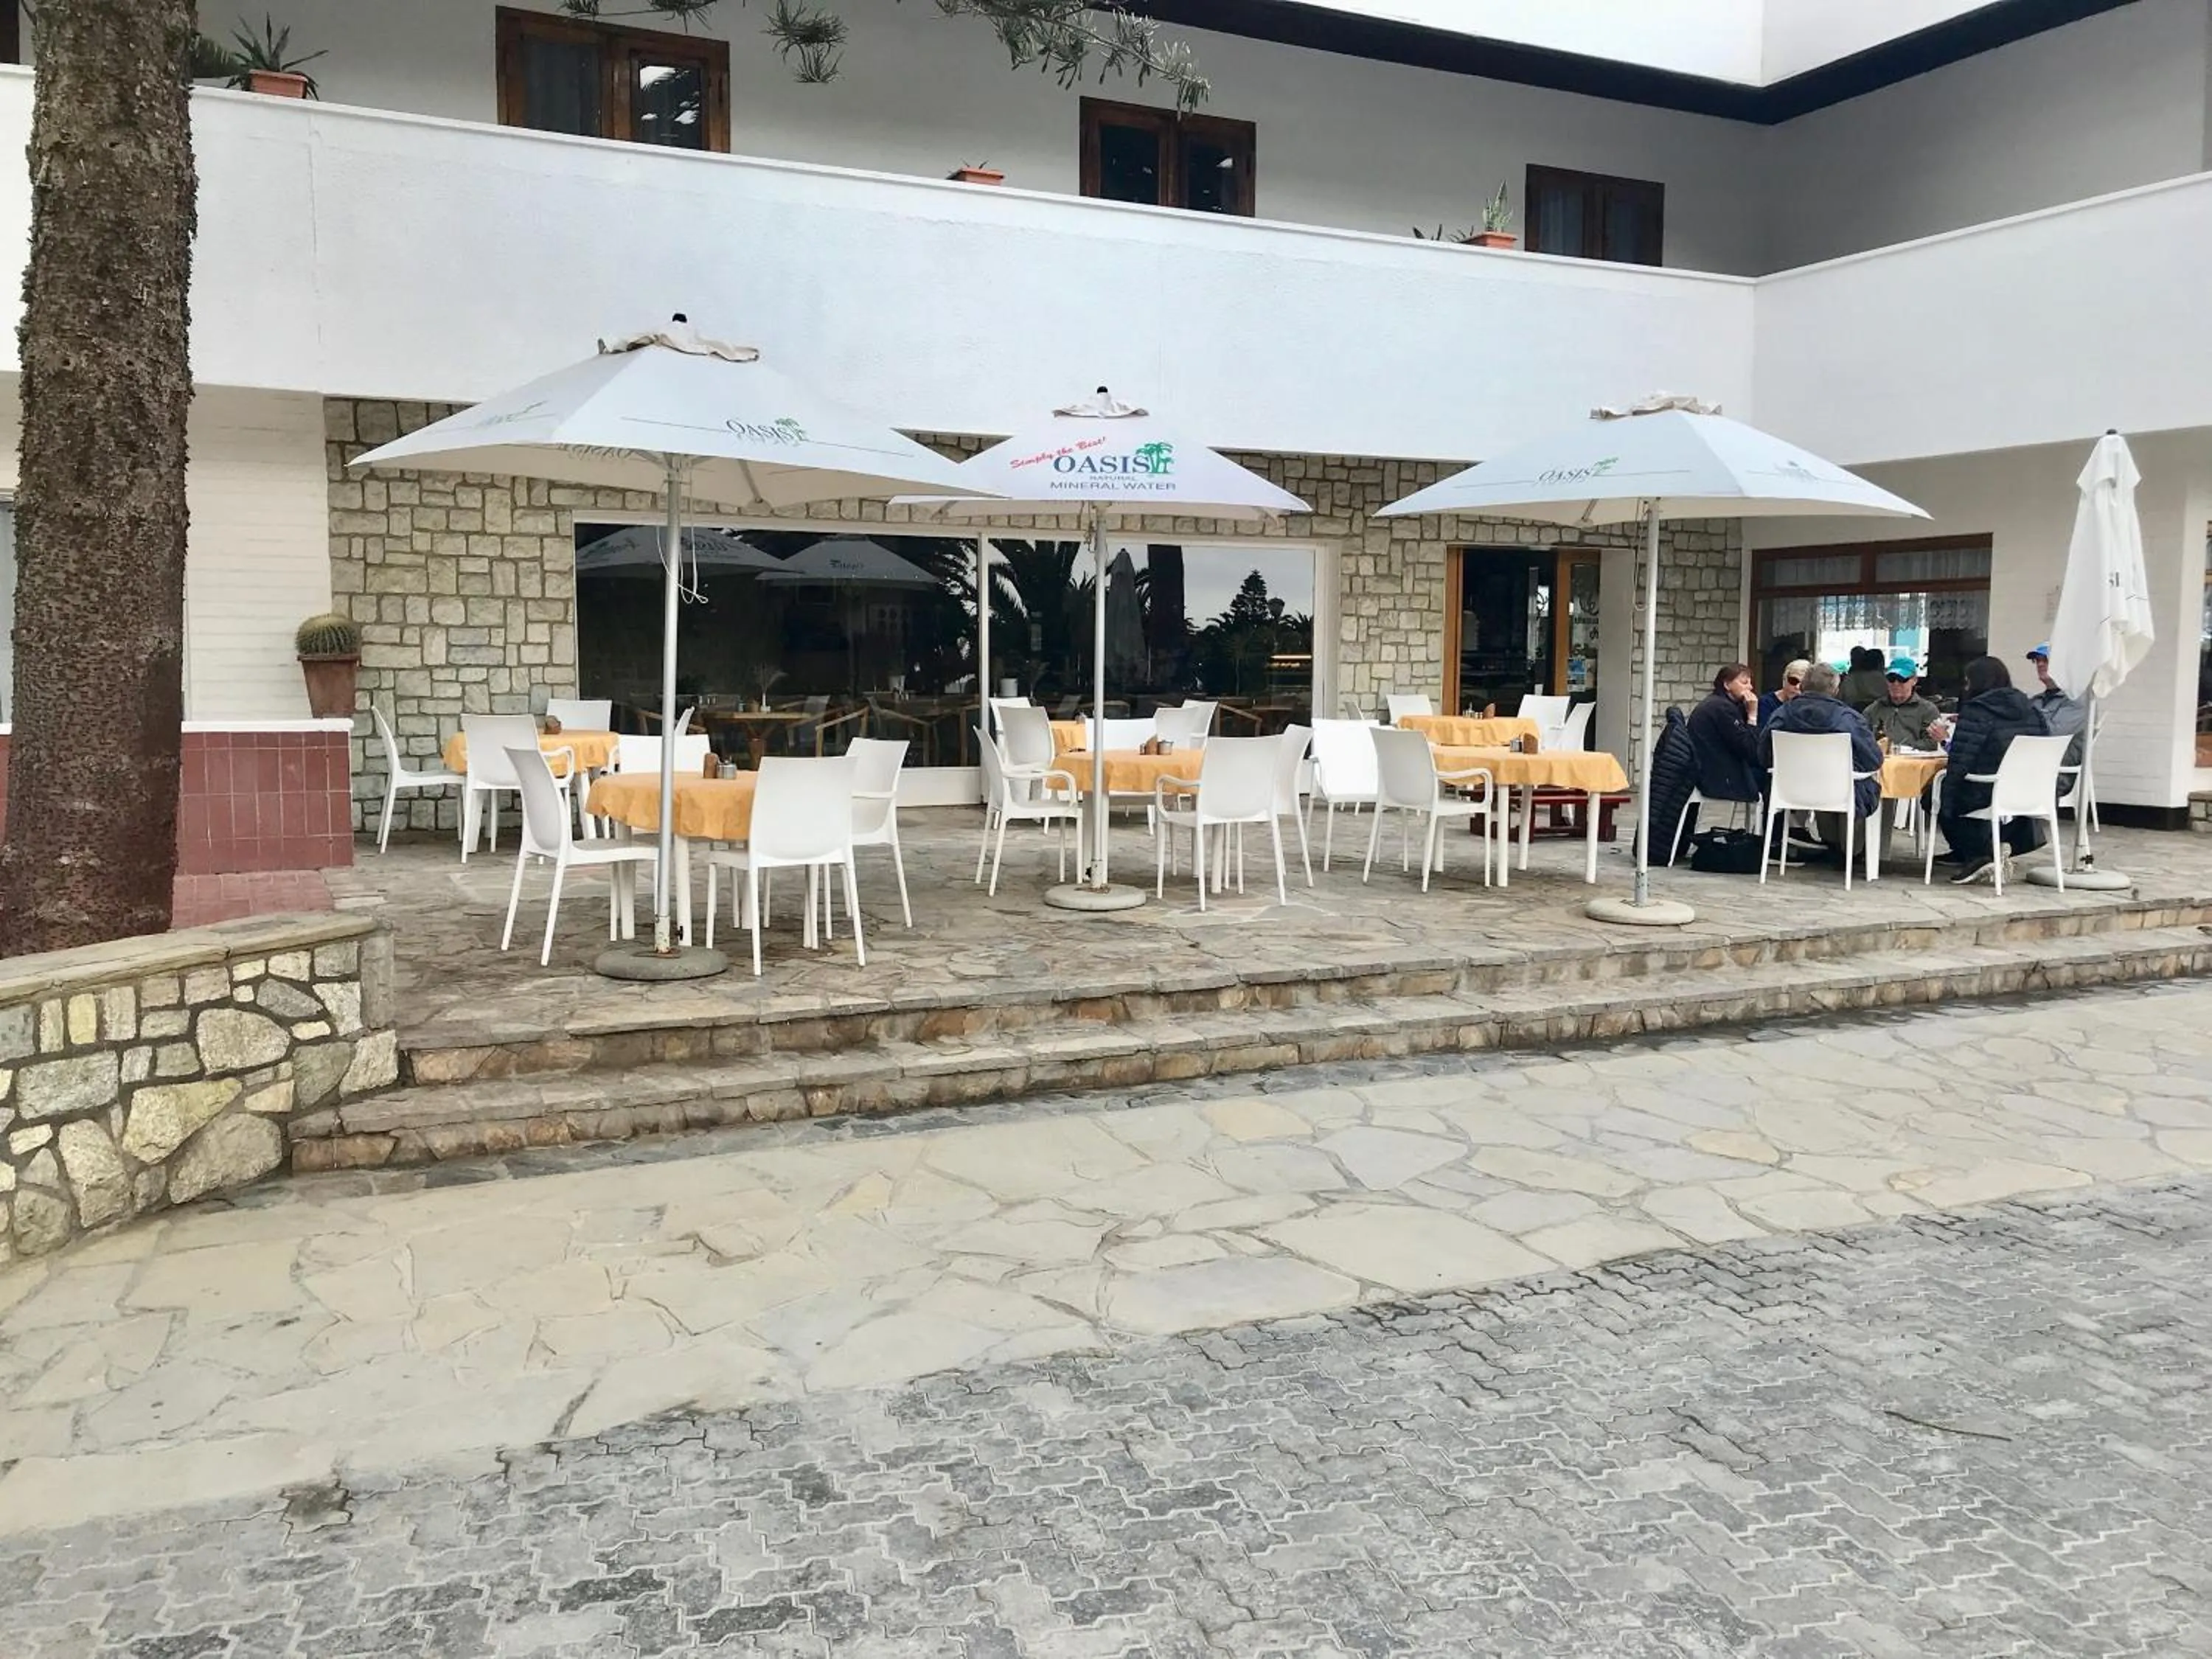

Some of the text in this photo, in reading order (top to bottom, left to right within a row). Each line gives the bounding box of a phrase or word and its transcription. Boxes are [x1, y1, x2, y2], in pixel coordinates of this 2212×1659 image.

[725, 419, 796, 445] OASIS
[1009, 436, 1106, 470] Simply the Best!
[1053, 454, 1151, 474] OASIS
[1050, 481, 1176, 490] MINERAL WATER
